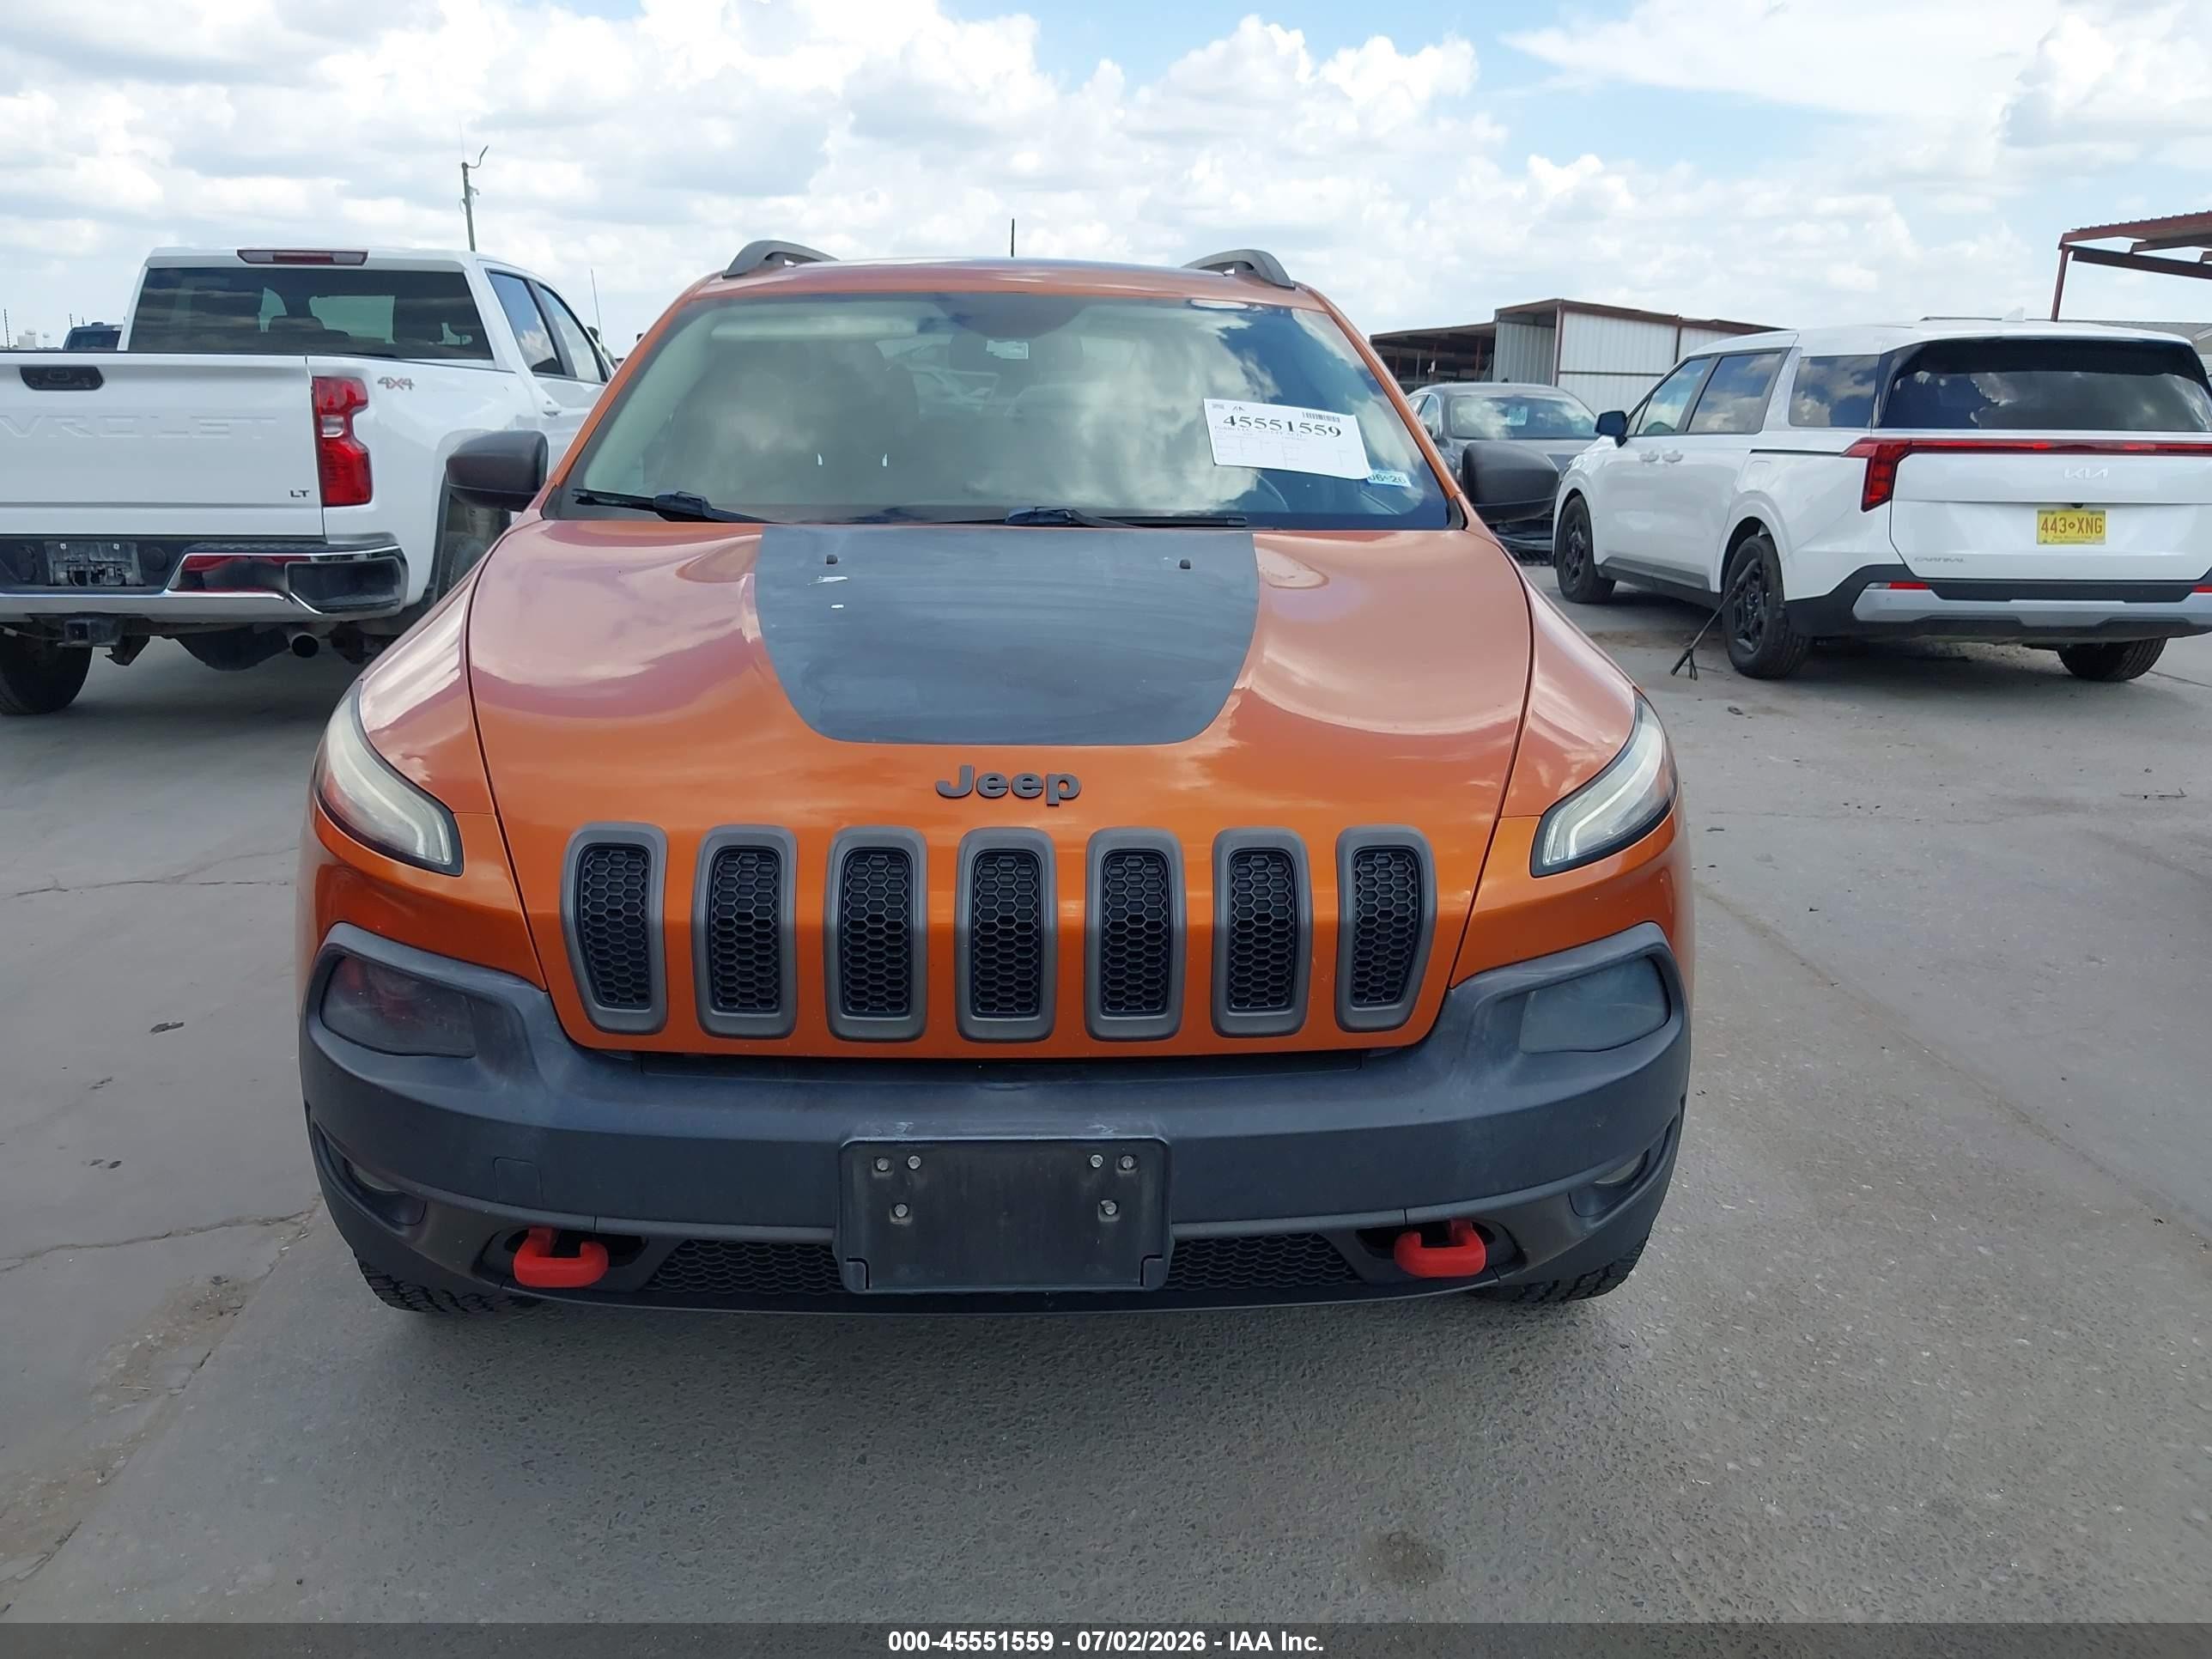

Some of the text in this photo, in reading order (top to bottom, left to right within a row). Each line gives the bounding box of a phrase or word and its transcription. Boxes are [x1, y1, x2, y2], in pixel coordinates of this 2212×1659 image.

[1223, 415, 1342, 438] 45551559
[2063, 467, 2109, 479] KIA
[289, 489, 310, 499] LT
[935, 764, 1081, 807] Jeep
